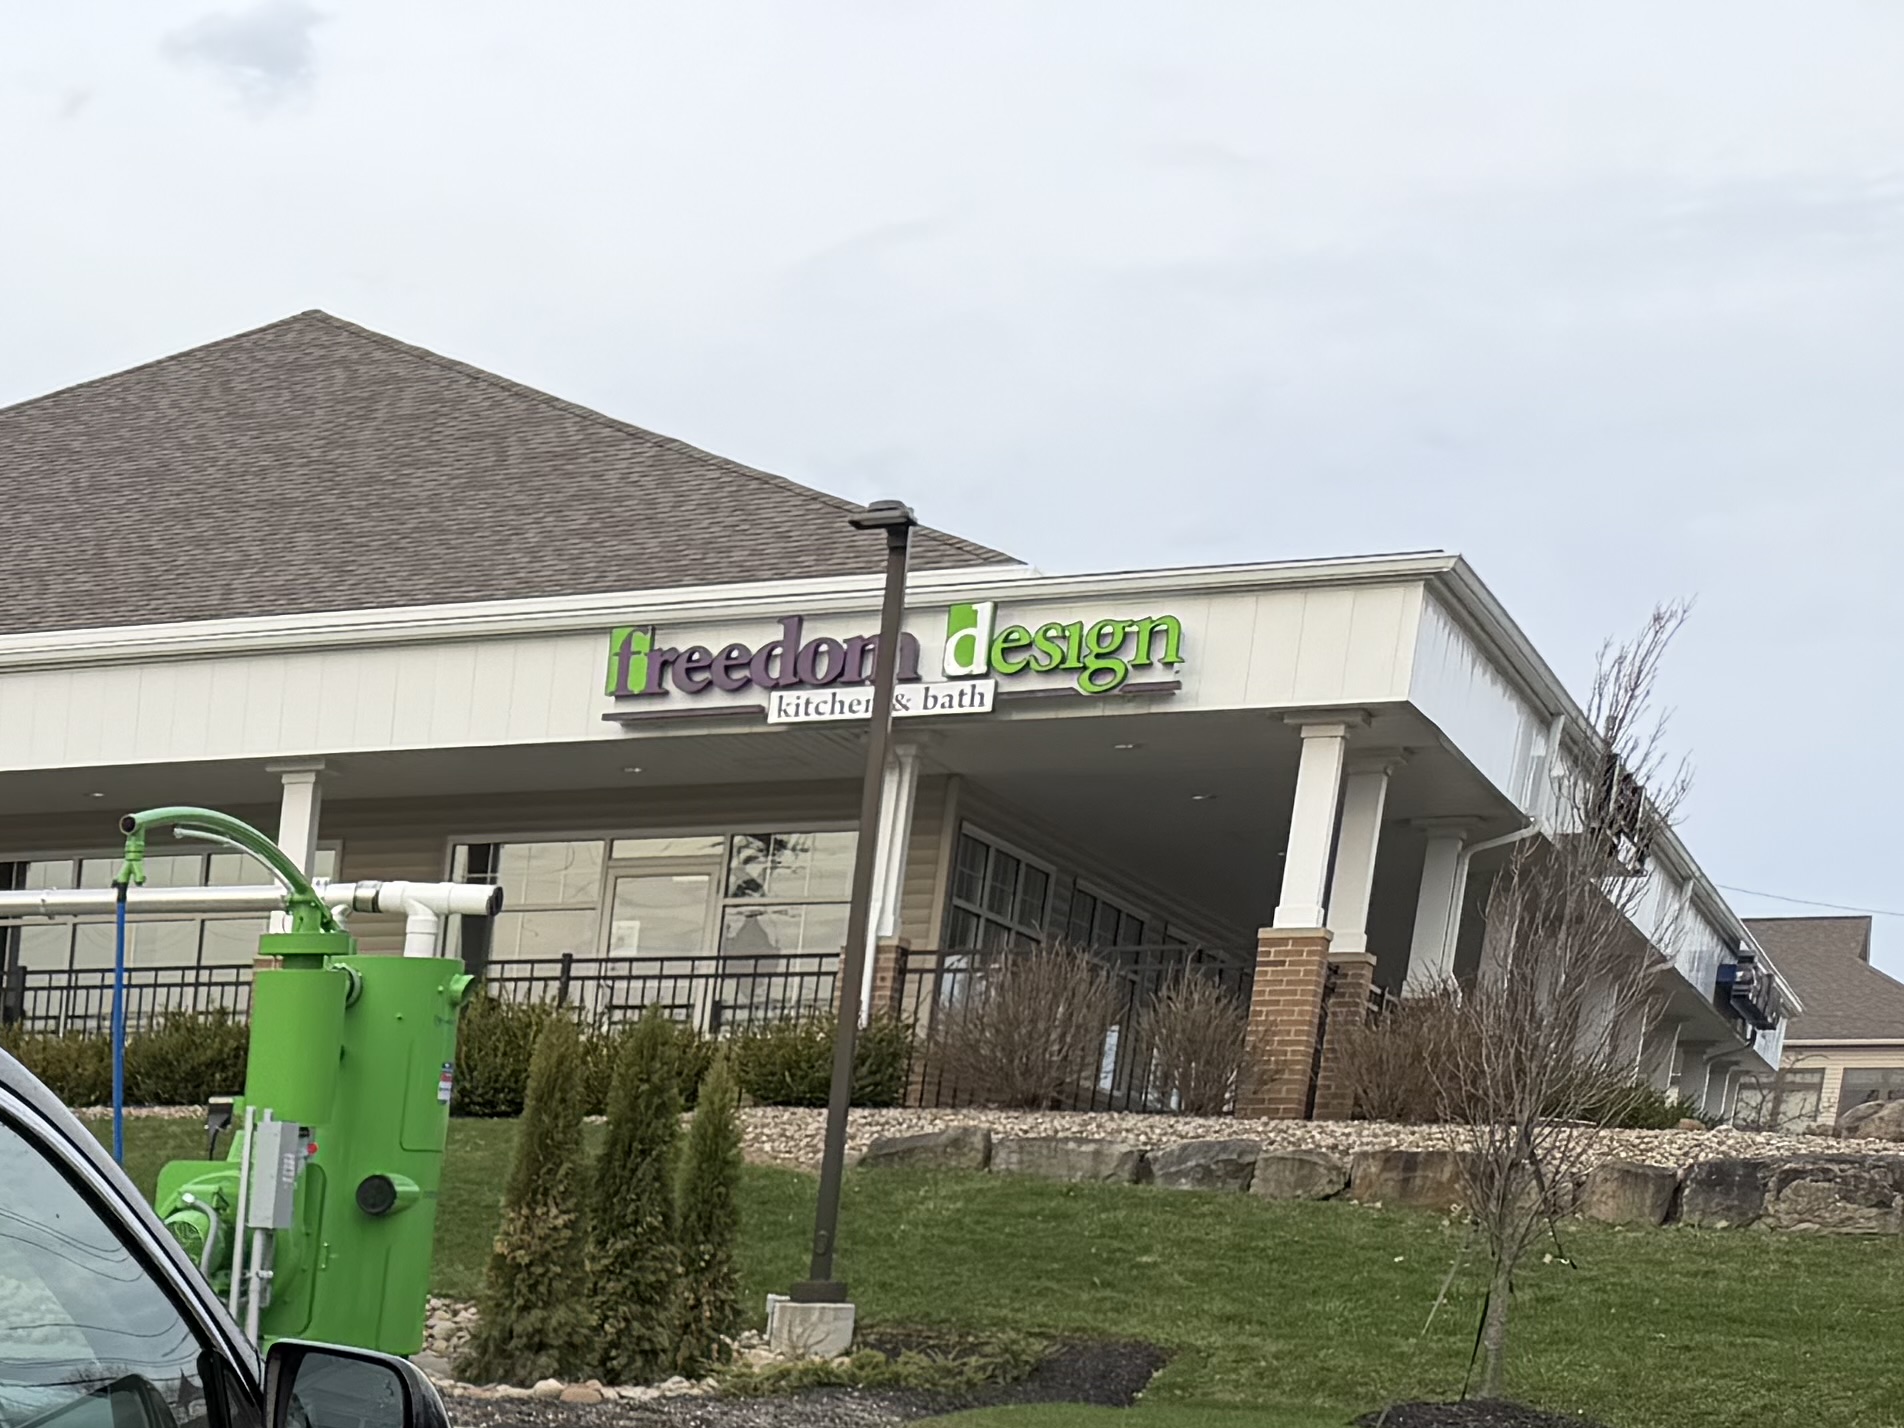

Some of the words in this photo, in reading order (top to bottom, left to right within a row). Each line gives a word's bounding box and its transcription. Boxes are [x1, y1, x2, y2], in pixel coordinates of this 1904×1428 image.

[609, 615, 922, 696] freedom
[943, 601, 1185, 693] design
[891, 693, 912, 712] &
[922, 684, 986, 711] bath
